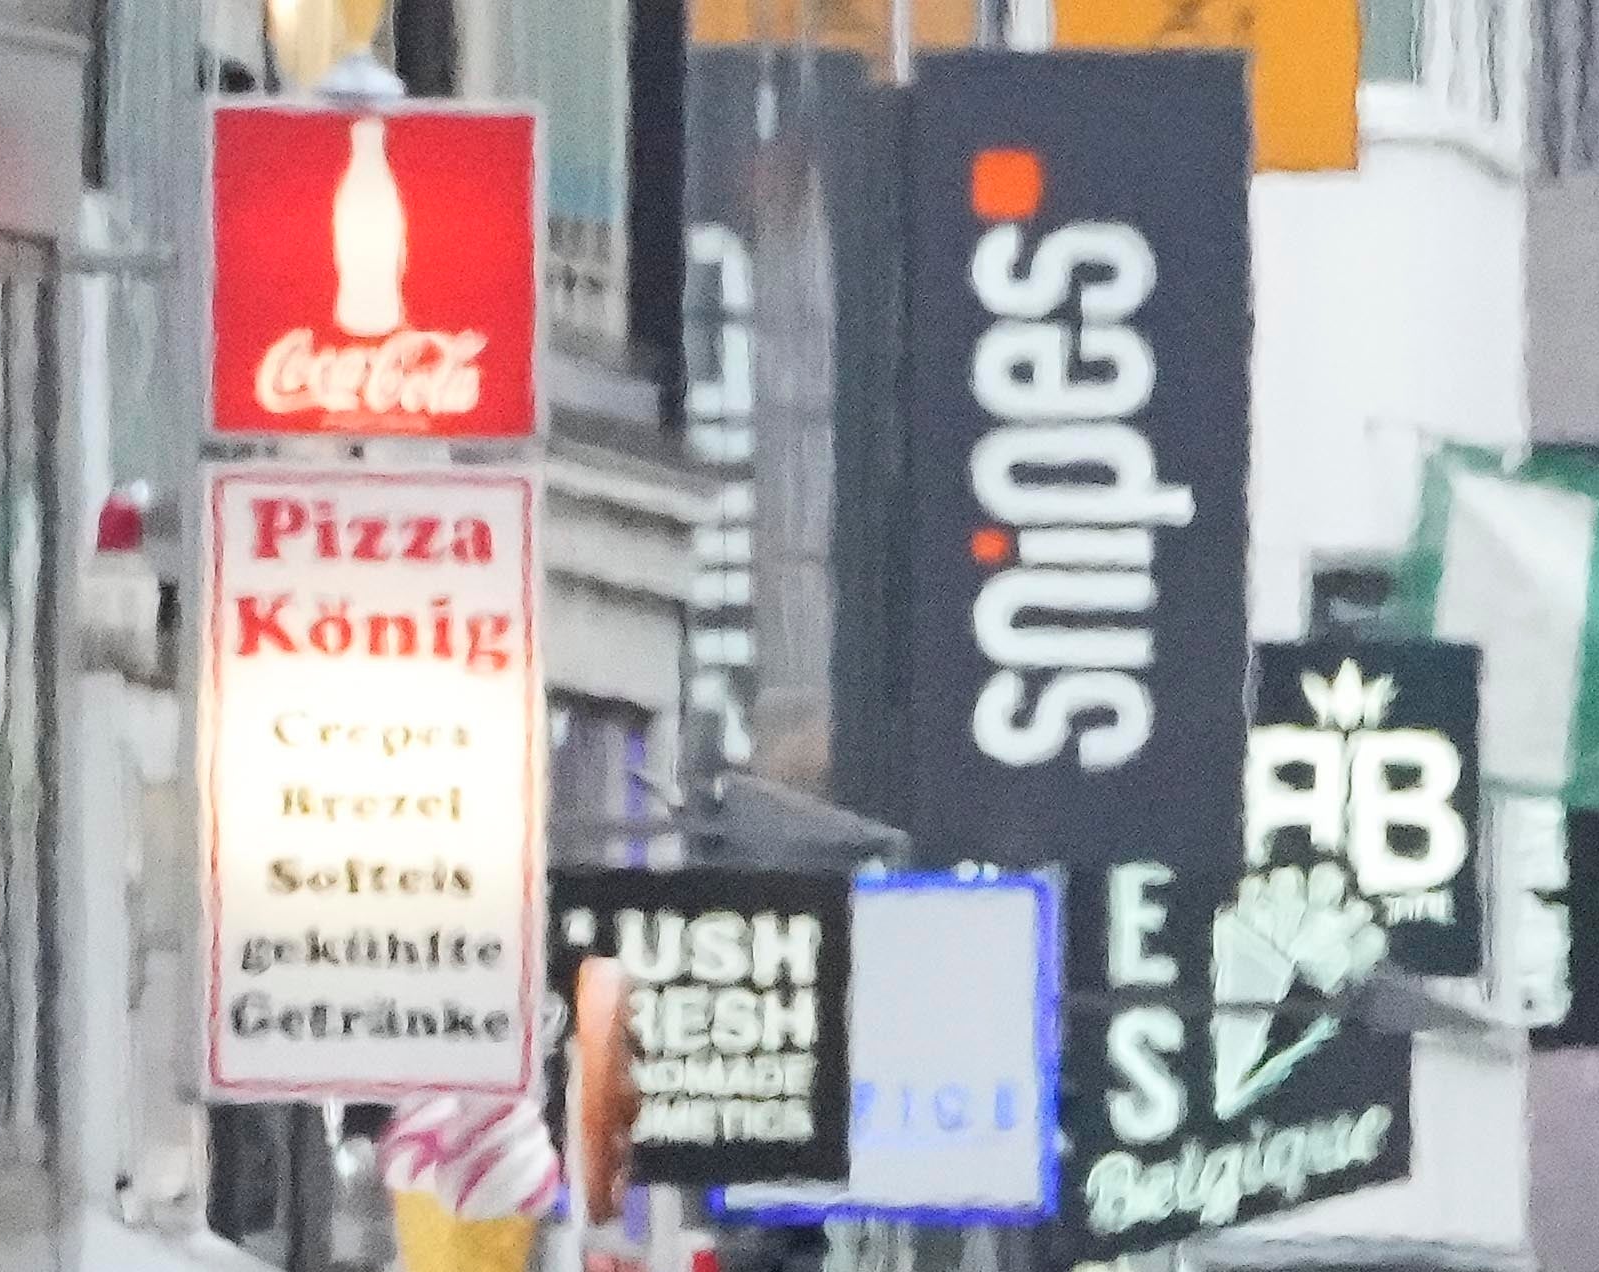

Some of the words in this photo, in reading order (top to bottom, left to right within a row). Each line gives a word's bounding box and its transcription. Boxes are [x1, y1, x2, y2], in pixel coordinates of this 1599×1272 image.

[249, 499, 495, 564] Pizza
[971, 218, 1199, 774] snipes
[235, 594, 513, 672] König
[239, 926, 504, 975] gekühlte
[563, 906, 823, 986] USH
[229, 990, 513, 1044] Getränke
[1086, 1103, 1393, 1234] Belgique
